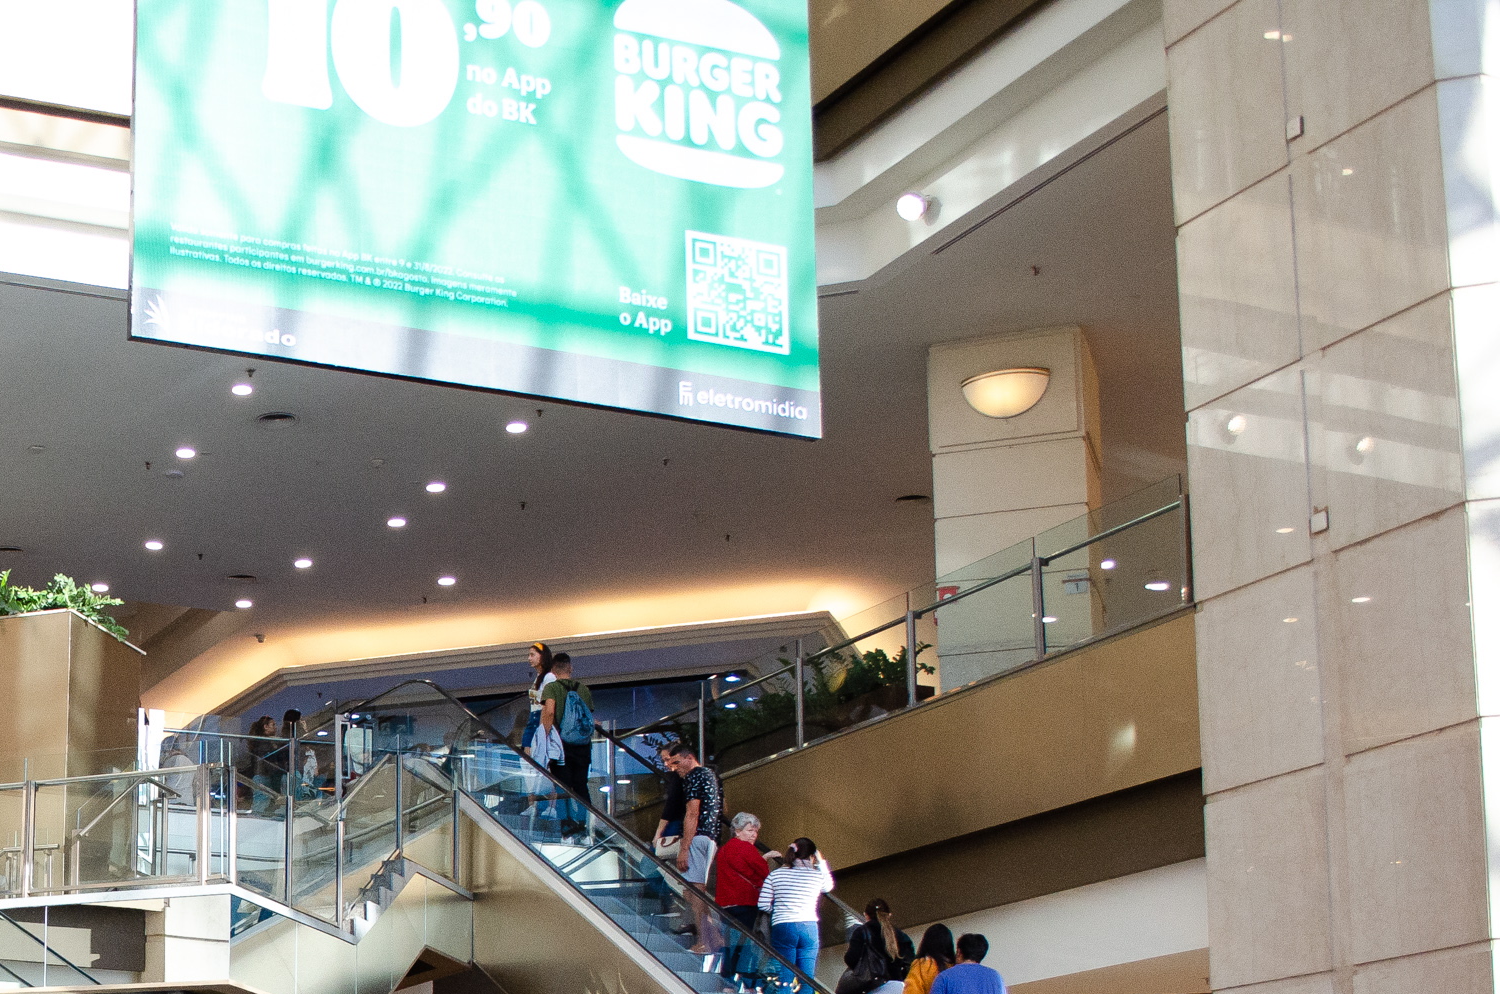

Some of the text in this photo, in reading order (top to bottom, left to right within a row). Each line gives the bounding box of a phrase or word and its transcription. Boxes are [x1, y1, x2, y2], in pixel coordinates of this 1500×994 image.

[466, 64, 552, 99] no App
[613, 33, 782, 103] BURGER
[466, 92, 539, 124] do BK
[614, 74, 784, 158] KING
[229, 244, 289, 262] participantes
[290, 253, 305, 264] em
[342, 251, 360, 262] App
[361, 252, 373, 262] BK
[224, 253, 250, 268] Todos
[251, 260, 262, 269] os
[263, 261, 297, 275] direitos
[382, 280, 404, 292] 2022
[404, 283, 435, 297] Burger
[435, 288, 456, 301] King
[619, 286, 668, 310] Baixe
[619, 311, 672, 336] o App
